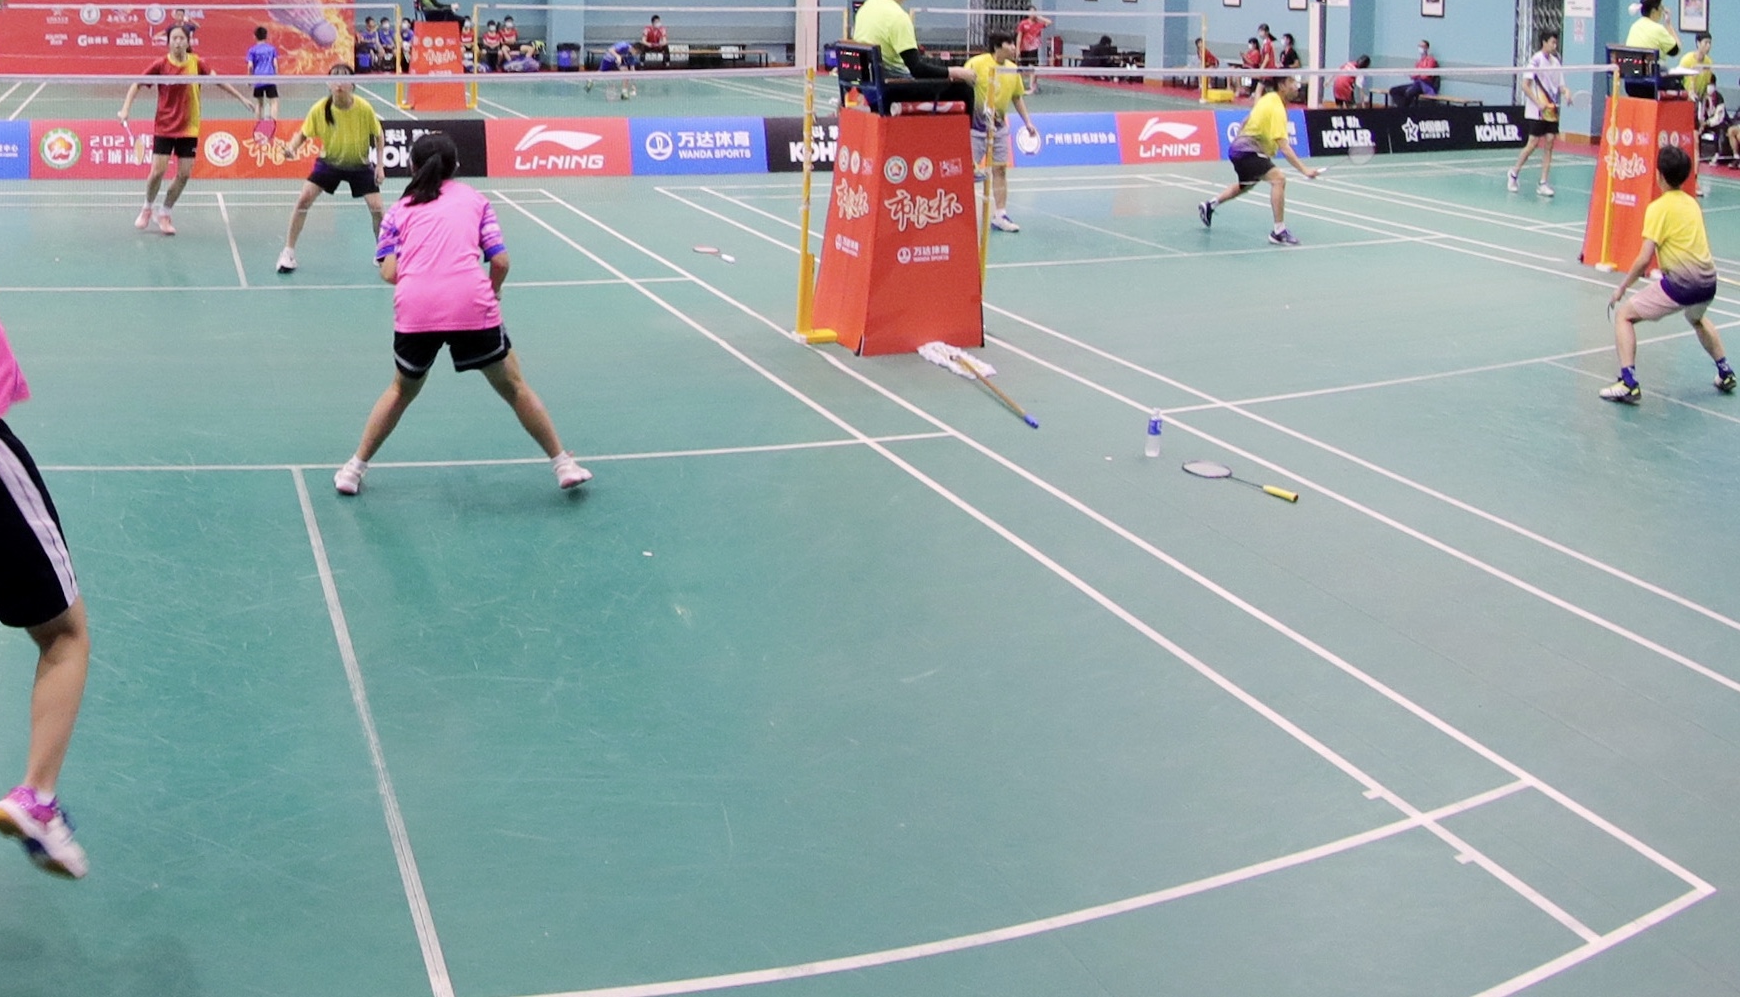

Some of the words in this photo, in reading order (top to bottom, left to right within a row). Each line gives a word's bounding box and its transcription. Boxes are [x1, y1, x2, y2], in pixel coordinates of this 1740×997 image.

[1331, 115, 1361, 128] 科勒
[678, 131, 750, 148] 万达体育
[1322, 128, 1373, 149] KOHLER
[1475, 124, 1520, 142] KOHLER
[678, 149, 711, 160] WANDA
[714, 148, 751, 159] SPORTS
[1139, 143, 1201, 157] LI-NING
[514, 155, 604, 170] LI-NING
[913, 245, 950, 255] 万达体育
